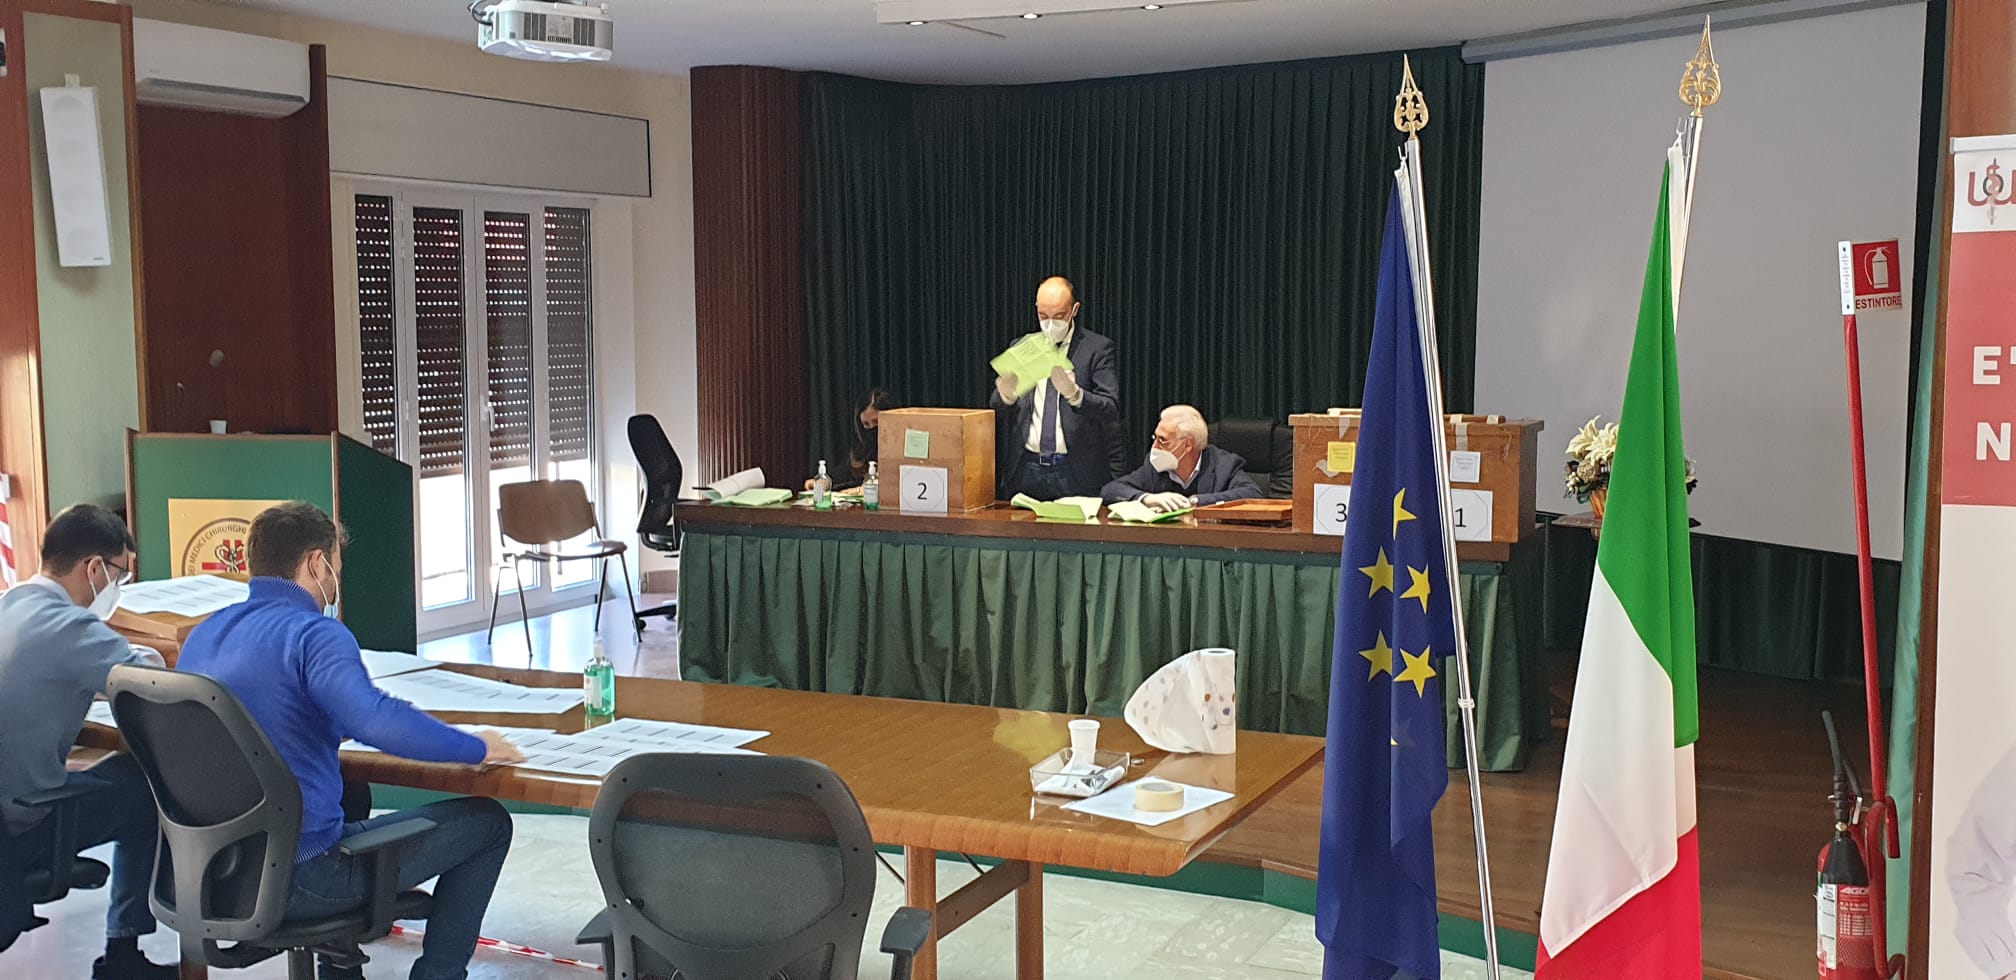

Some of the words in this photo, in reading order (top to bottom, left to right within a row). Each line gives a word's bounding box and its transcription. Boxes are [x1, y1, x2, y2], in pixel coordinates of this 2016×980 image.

[1855, 295, 1902, 309] ESTINTORE
[1973, 345, 2016, 385] E
[917, 482, 928, 500] 2
[1335, 502, 1347, 523] 3
[1455, 507, 1467, 528] 1
[189, 538, 207, 563] MEDICI
